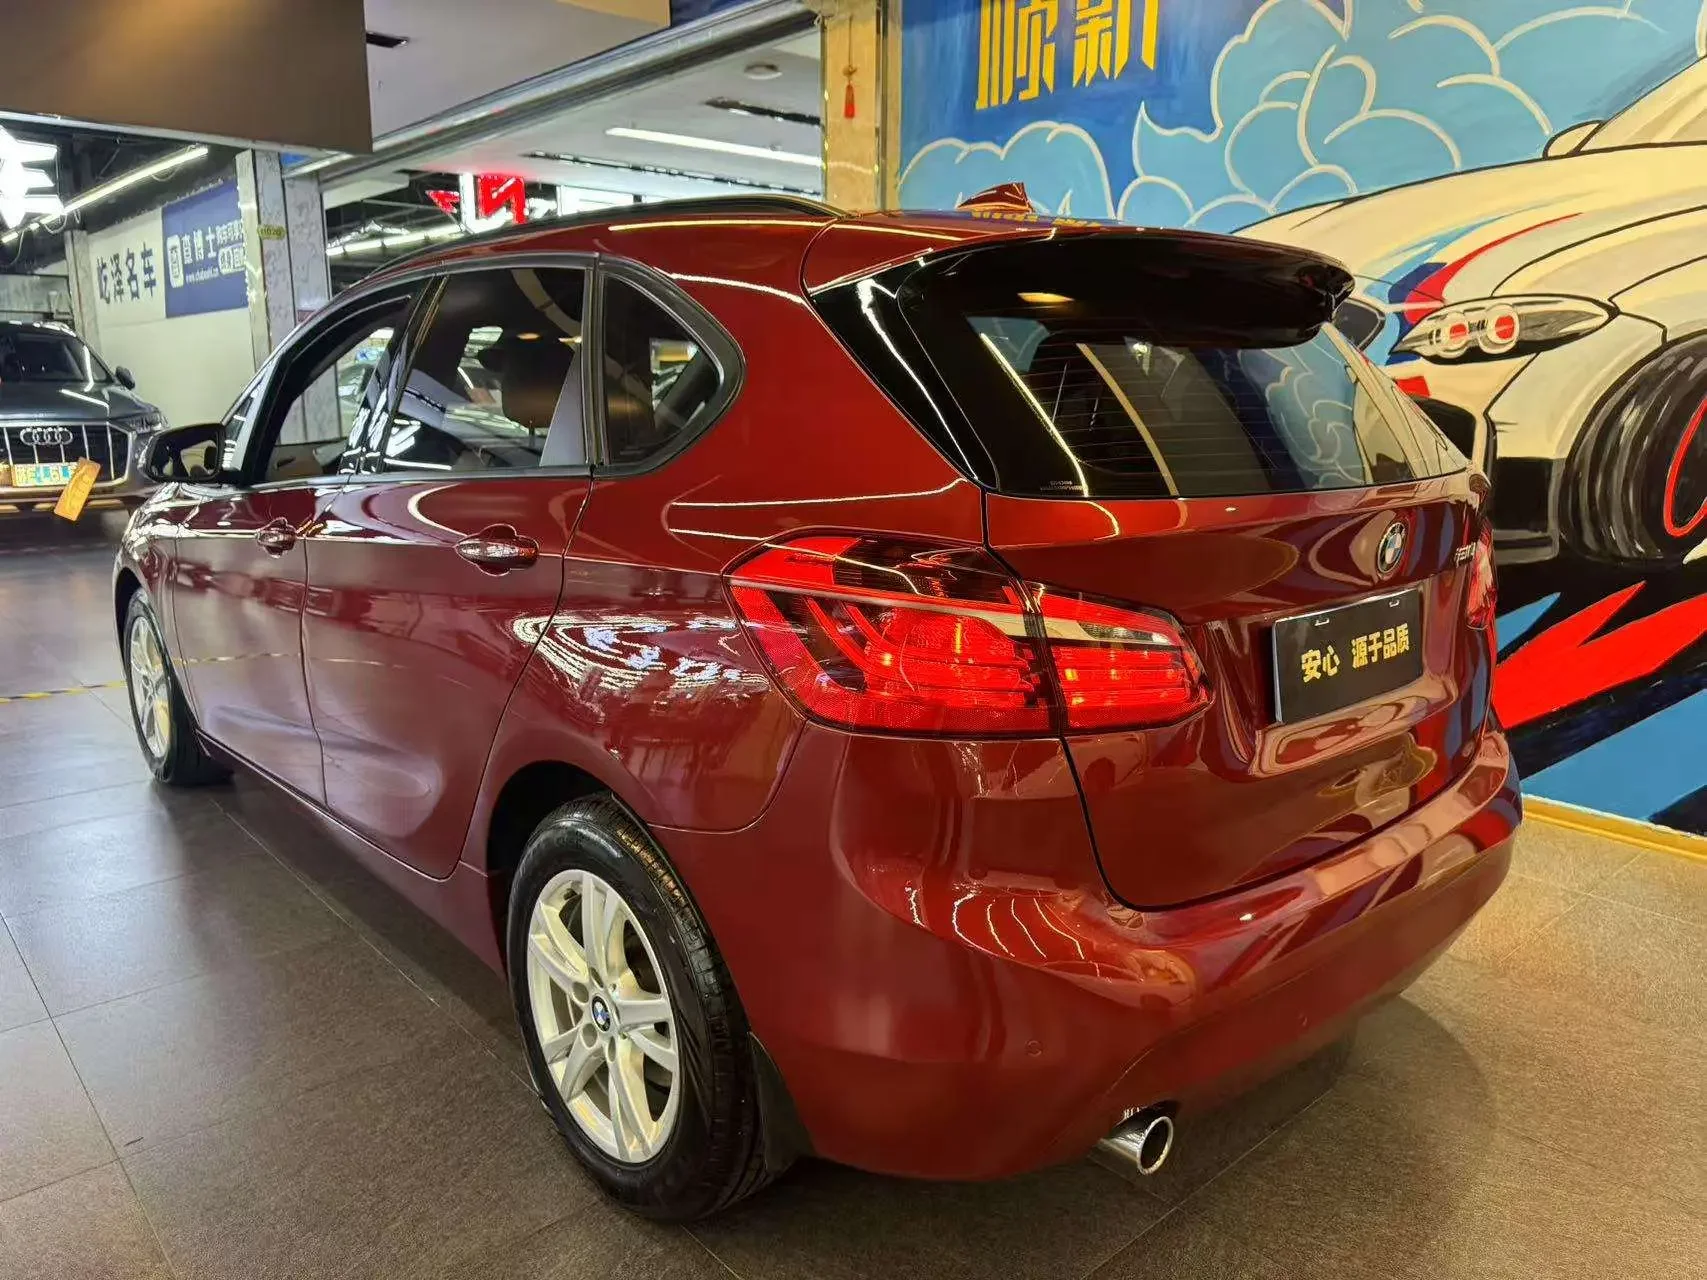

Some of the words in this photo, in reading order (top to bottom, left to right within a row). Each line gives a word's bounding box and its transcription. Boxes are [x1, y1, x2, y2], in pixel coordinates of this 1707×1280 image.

[1301, 644, 1341, 683] 安心
[1351, 623, 1410, 669] 源于品质
